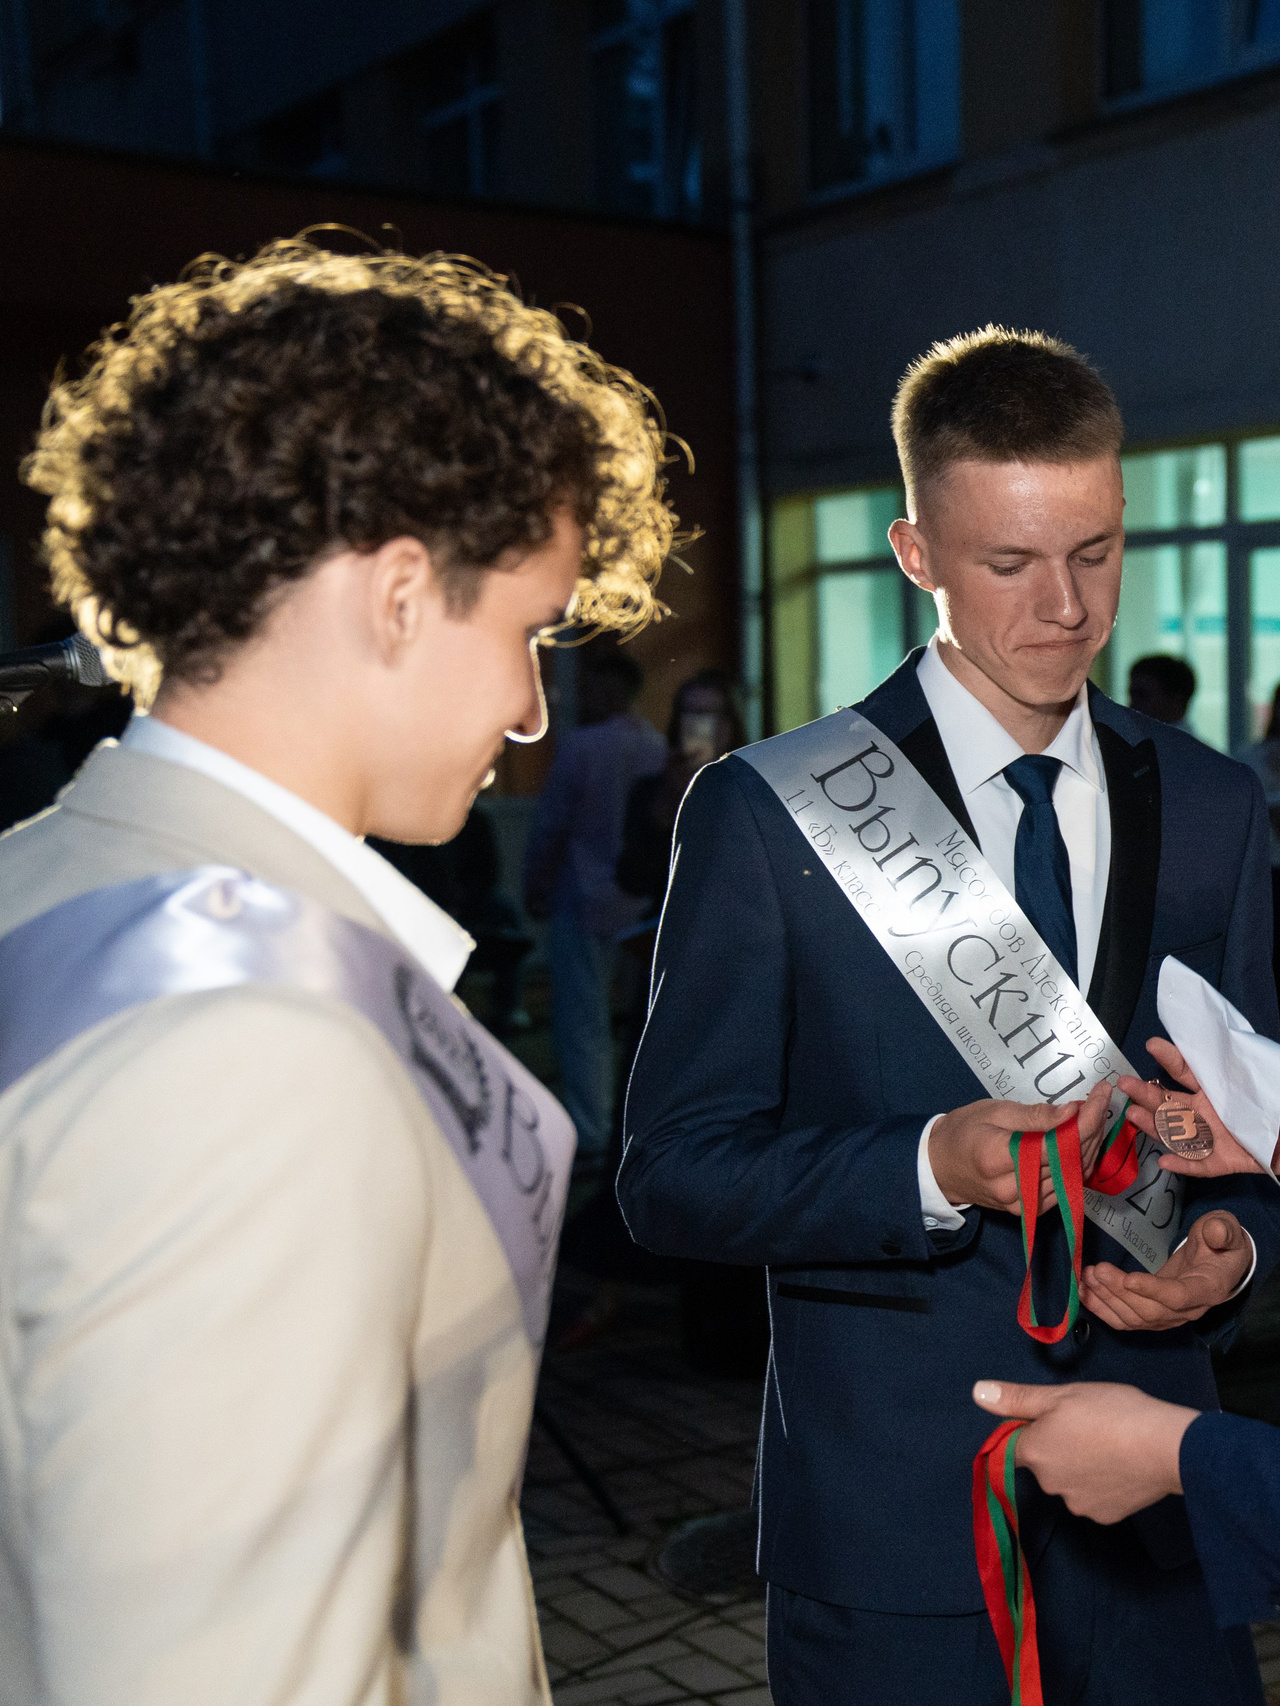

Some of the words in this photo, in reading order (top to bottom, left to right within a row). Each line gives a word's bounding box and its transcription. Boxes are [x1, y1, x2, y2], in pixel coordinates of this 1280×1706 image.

[783, 788, 814, 817] 11
[808, 822, 838, 856] «Б»
[833, 860, 881, 918] класс
[810, 740, 1113, 1120] Выпускни
[904, 950, 960, 1025] Средняя
[955, 1025, 993, 1071] школа
[988, 1068, 1016, 1099] №1
[1121, 1216, 1158, 1264] Чкалова
